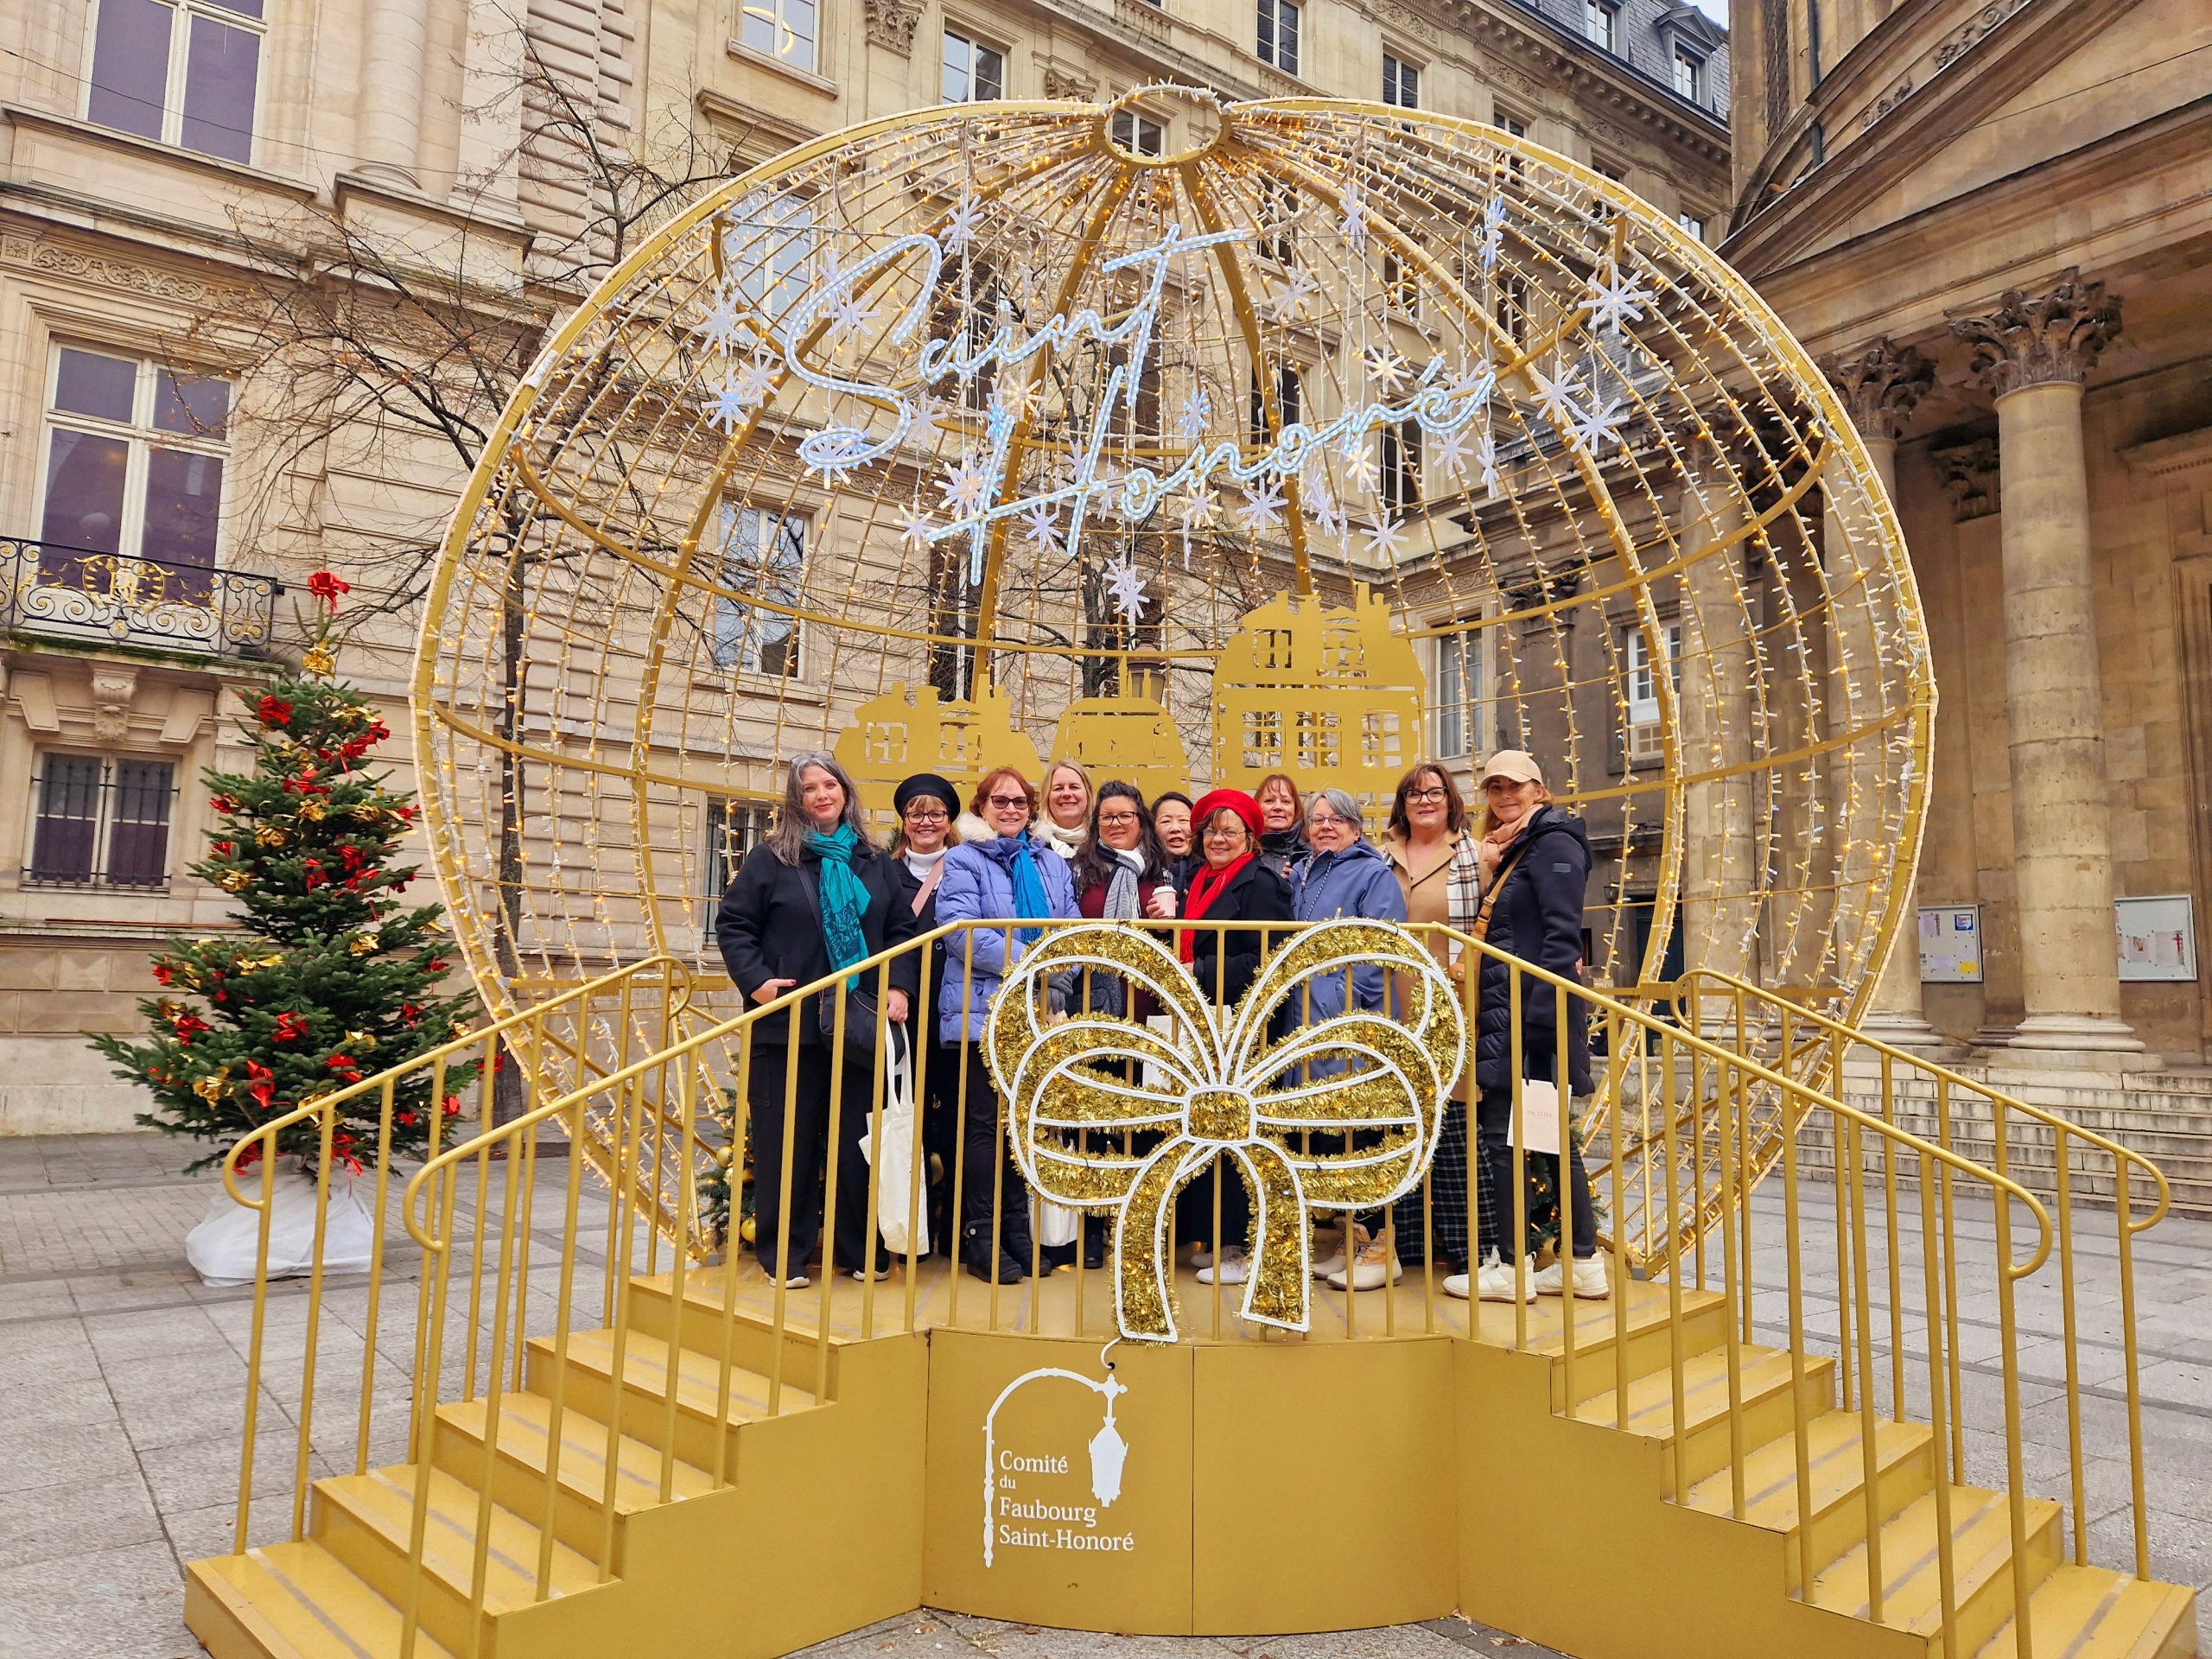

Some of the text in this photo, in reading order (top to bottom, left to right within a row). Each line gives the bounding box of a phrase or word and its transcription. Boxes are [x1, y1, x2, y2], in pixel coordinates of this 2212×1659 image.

[926, 355, 1497, 586] Honoré
[999, 1450, 1069, 1474] Comité
[999, 1474, 1017, 1489] du
[999, 1496, 1096, 1528] Faubourg
[999, 1524, 1135, 1552] Saint-Honoré
